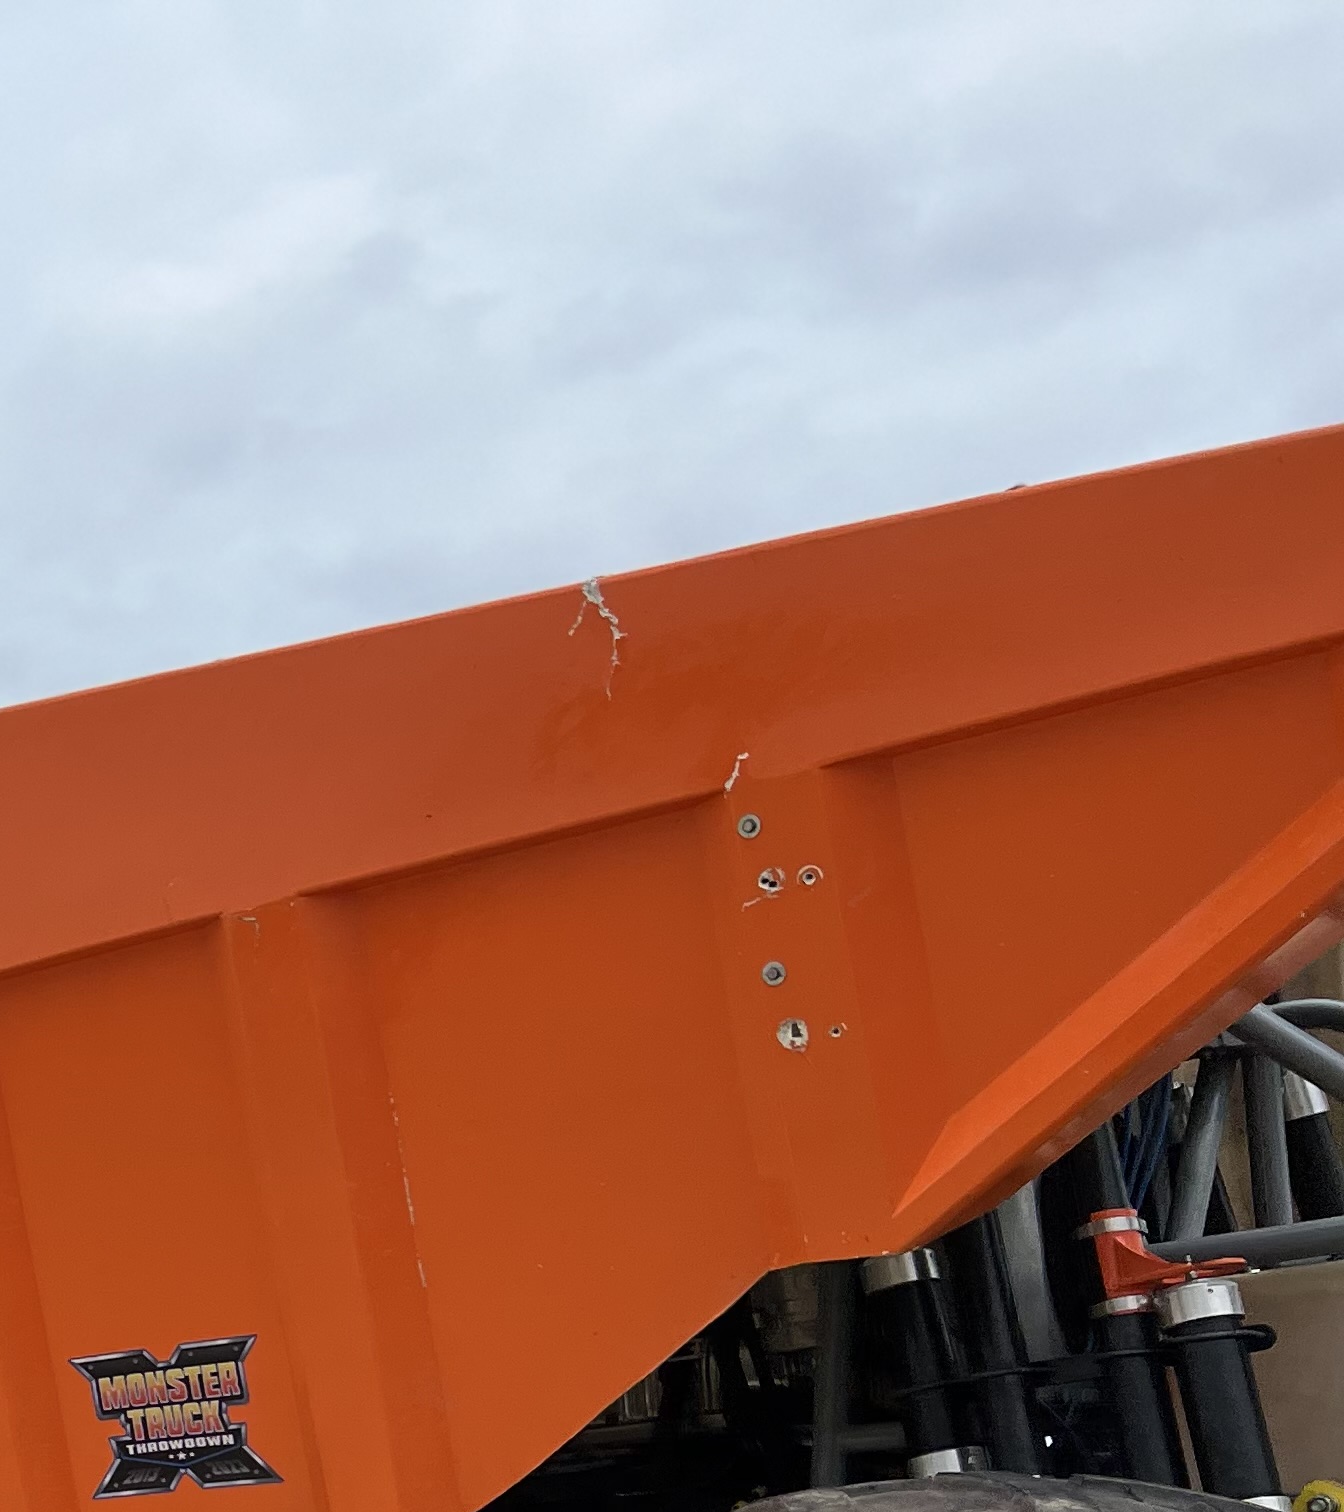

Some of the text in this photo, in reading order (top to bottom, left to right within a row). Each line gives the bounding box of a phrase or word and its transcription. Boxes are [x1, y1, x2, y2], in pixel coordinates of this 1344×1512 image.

[98, 1361, 241, 1411] MONSTER
[126, 1400, 225, 1441] TRUCK
[126, 1434, 235, 1455] THROWDOWN
